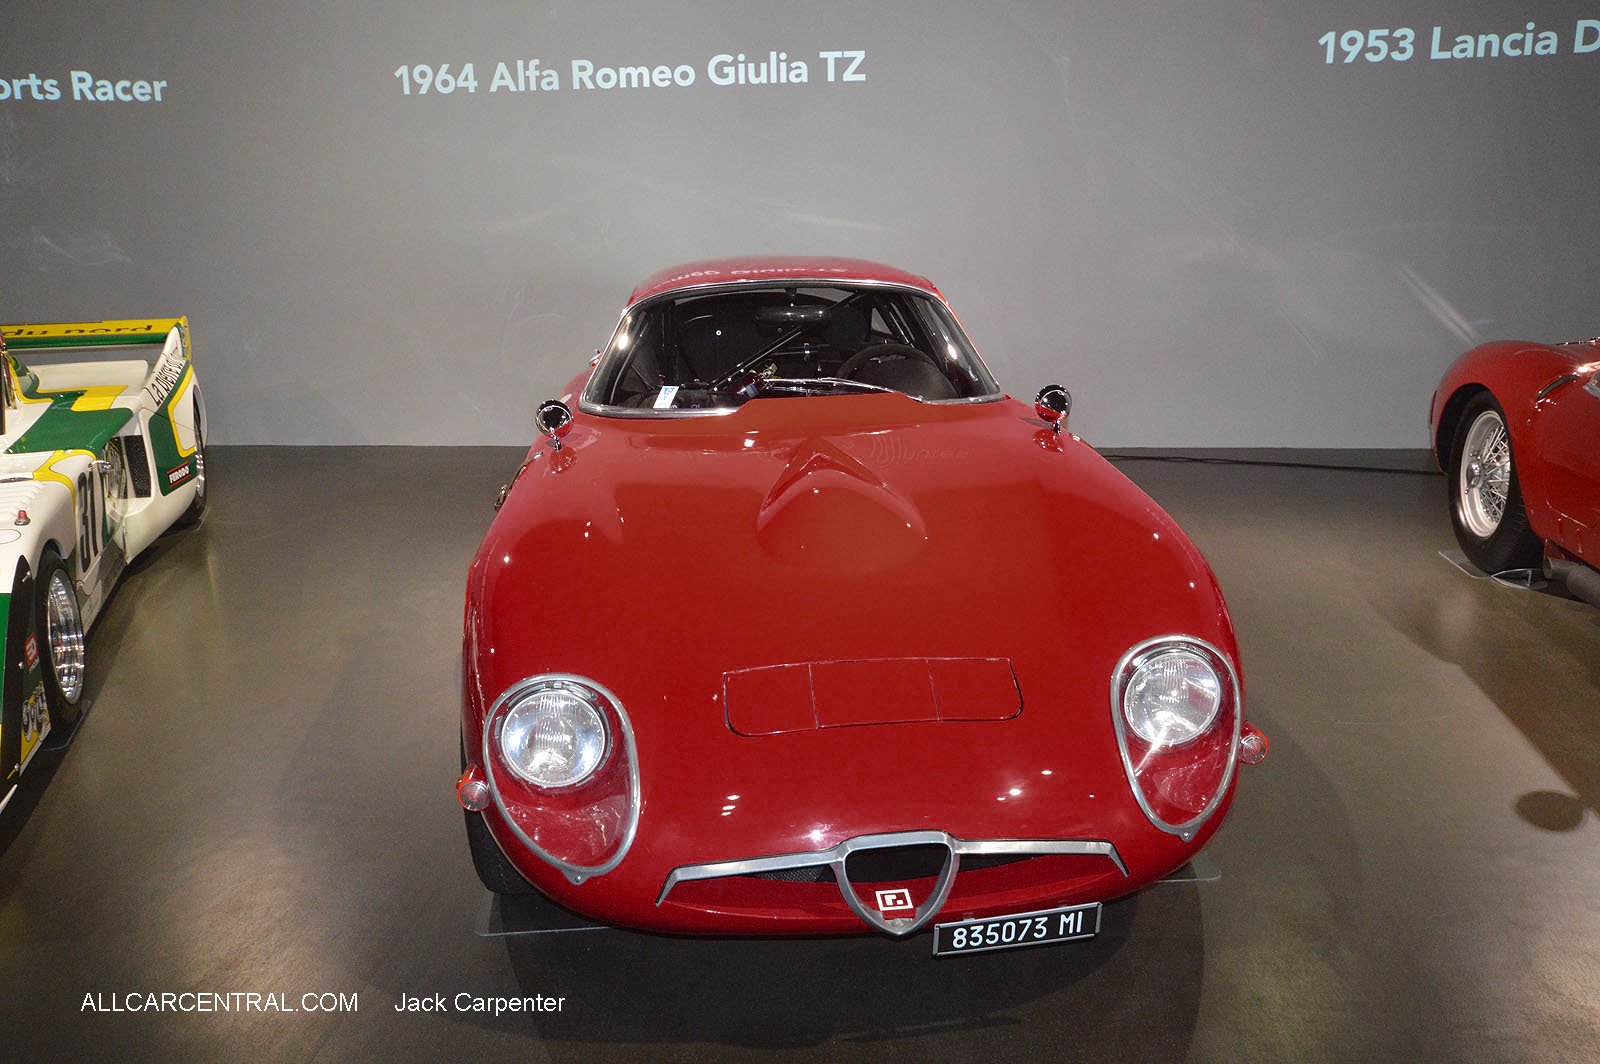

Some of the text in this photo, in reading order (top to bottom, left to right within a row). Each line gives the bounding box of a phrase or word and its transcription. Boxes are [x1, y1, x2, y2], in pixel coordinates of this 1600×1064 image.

[1318, 27, 1416, 64] 1953
[1430, 21, 1558, 60] Lancia
[70, 70, 168, 102] Racer
[394, 50, 866, 95] 1964 Alfa Romeo Giulia TZ
[64, 325, 152, 335] nord
[144, 382, 165, 407] La
[952, 911, 1083, 949] 835073 MI
